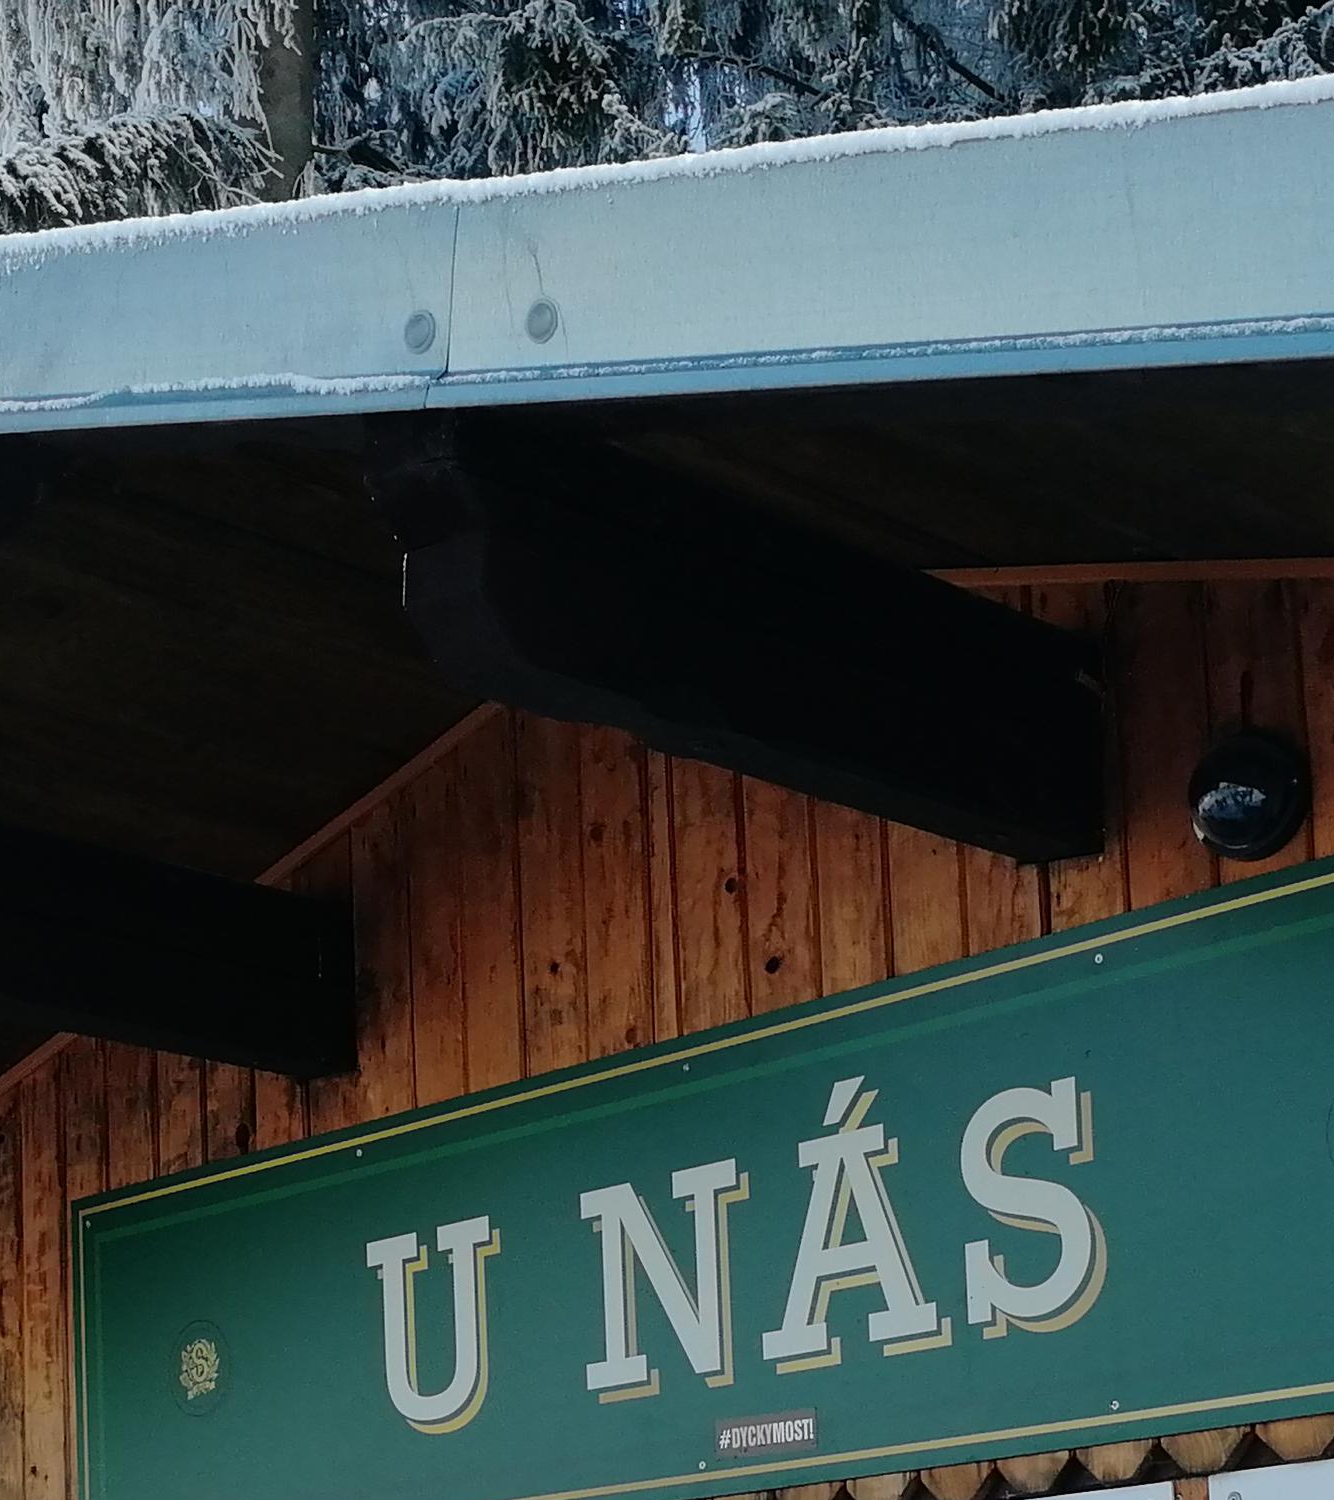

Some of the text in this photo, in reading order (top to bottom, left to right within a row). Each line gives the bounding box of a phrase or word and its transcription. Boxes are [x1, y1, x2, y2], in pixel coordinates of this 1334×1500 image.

[366, 1075, 1107, 1434] U NÁS
[719, 1418, 814, 1449] #DYCKYMOST!
